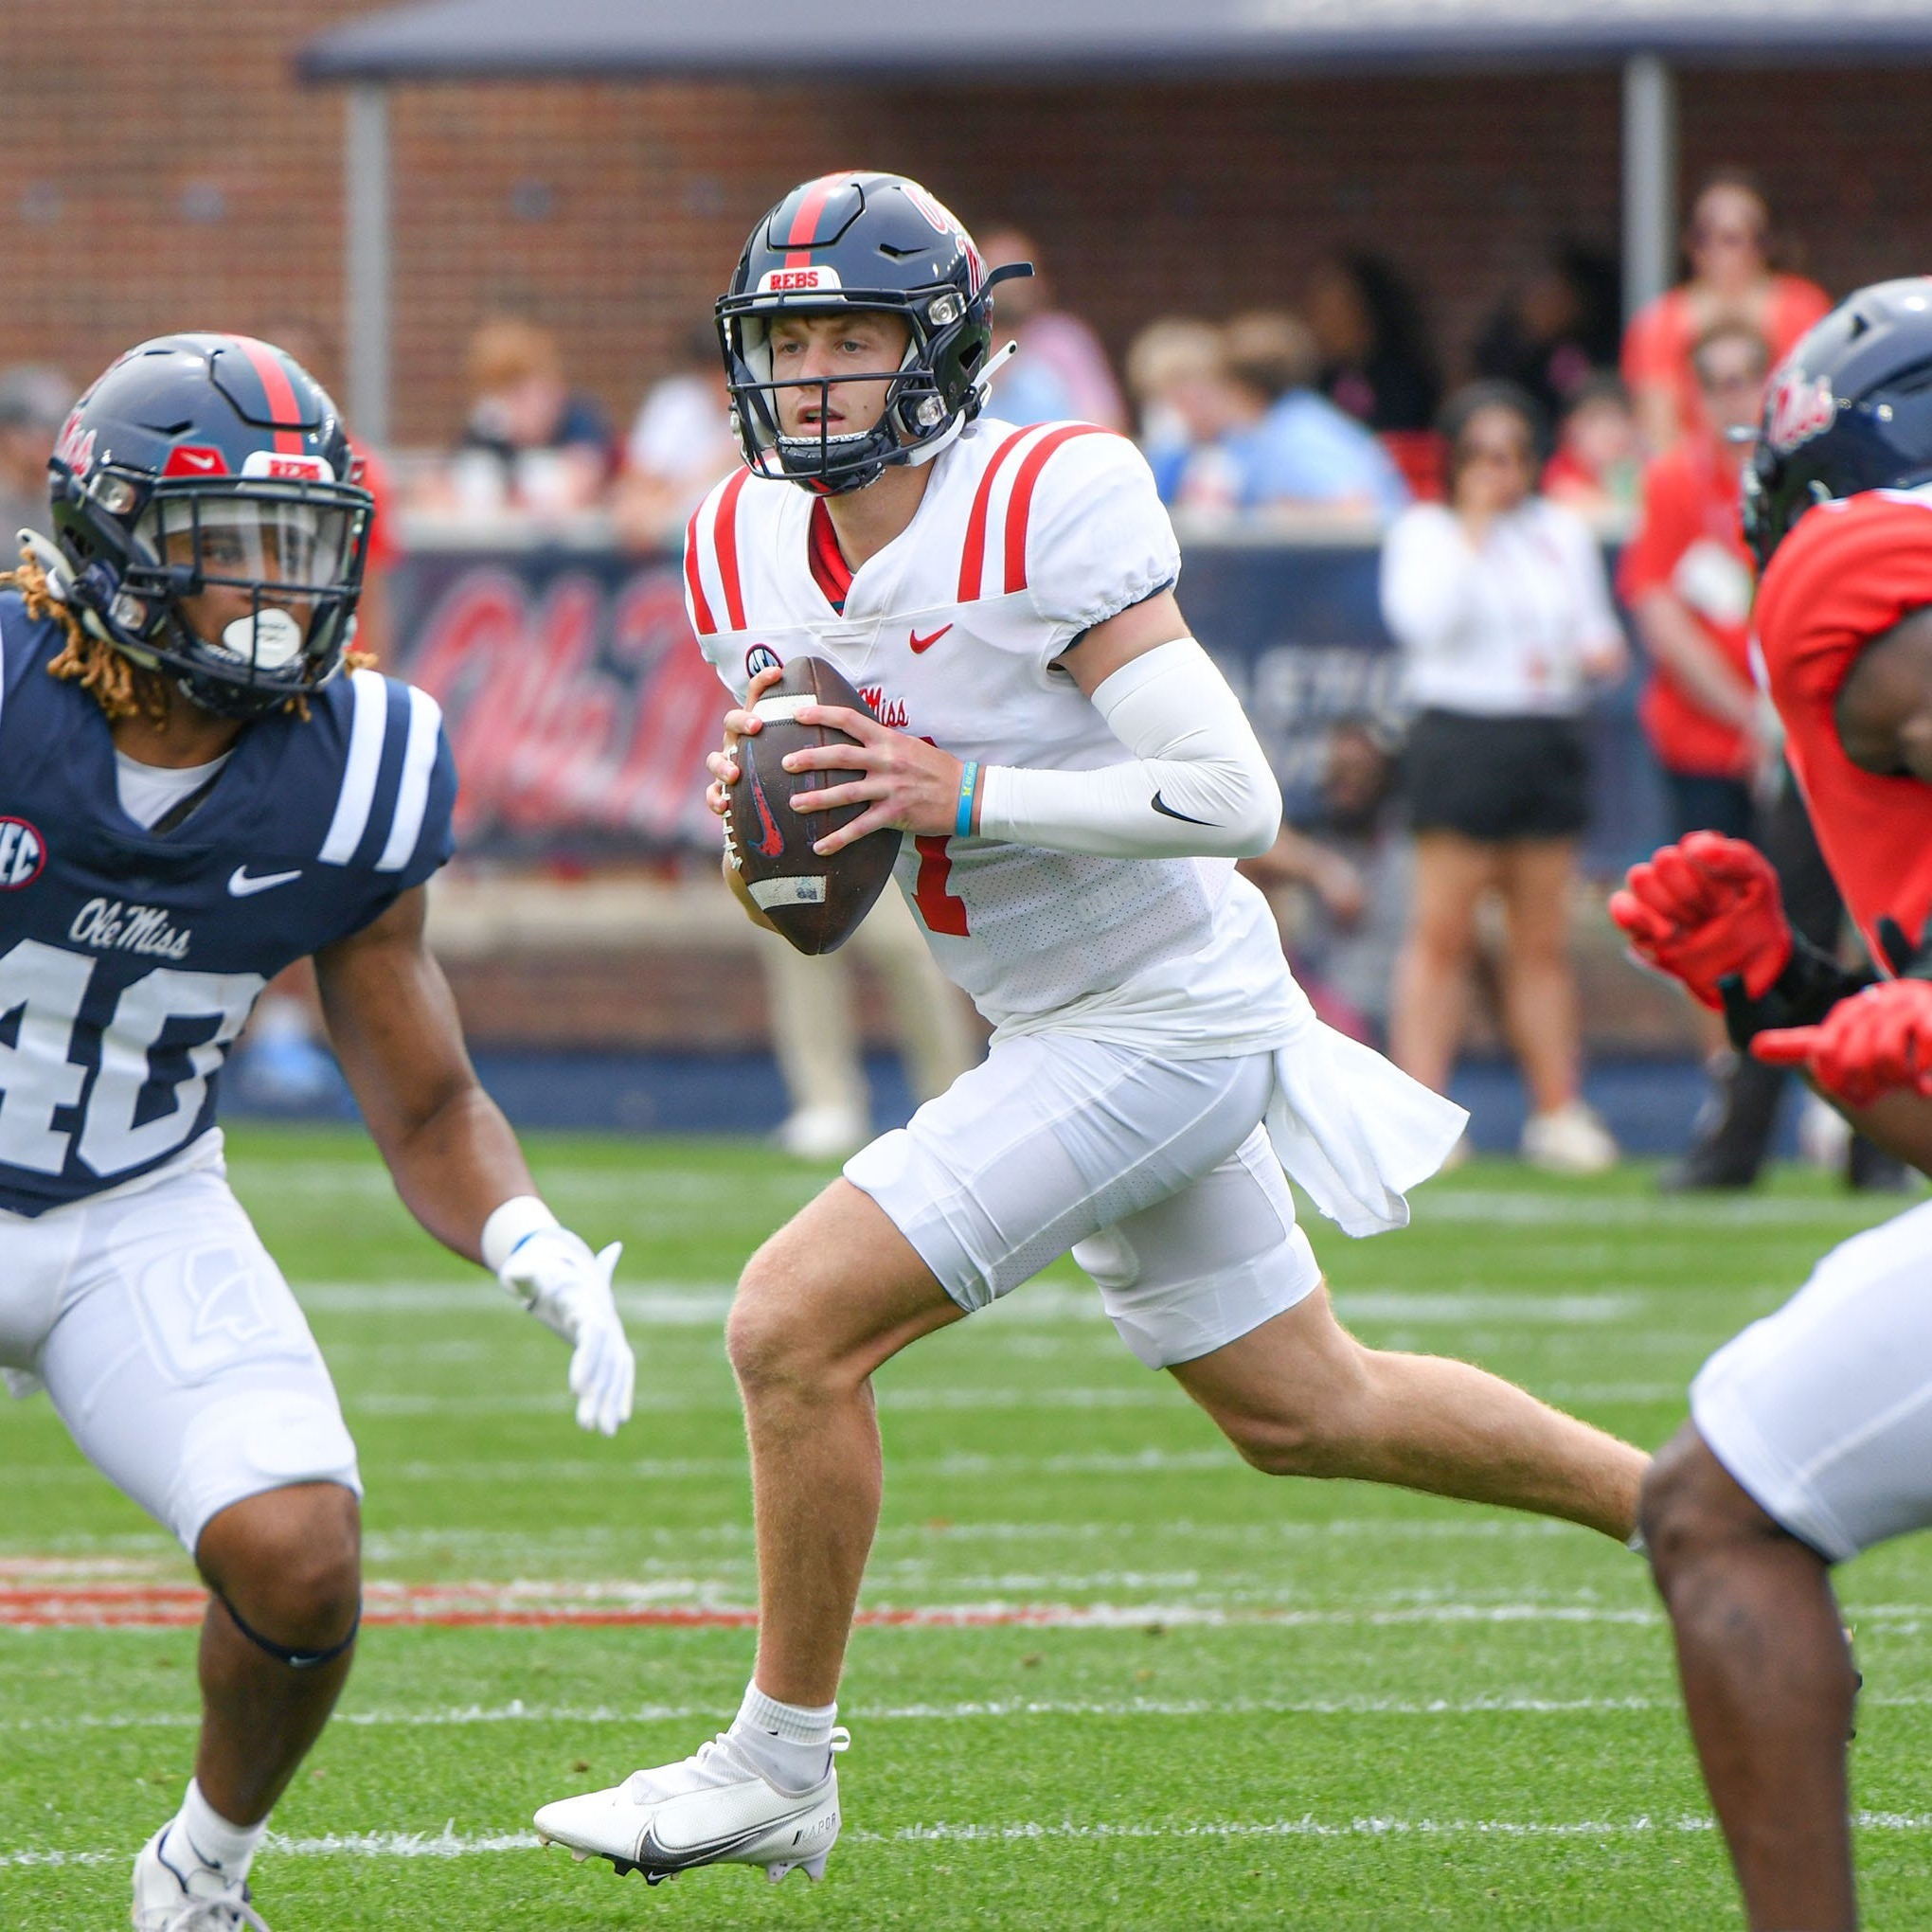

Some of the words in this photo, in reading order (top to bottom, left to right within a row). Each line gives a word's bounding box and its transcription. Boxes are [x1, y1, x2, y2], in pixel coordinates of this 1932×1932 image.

[769, 271, 819, 291] REBS
[0, 821, 39, 885] EC
[68, 896, 123, 949] Ole
[115, 904, 192, 960] Miss
[0, 938, 267, 1177] 40
